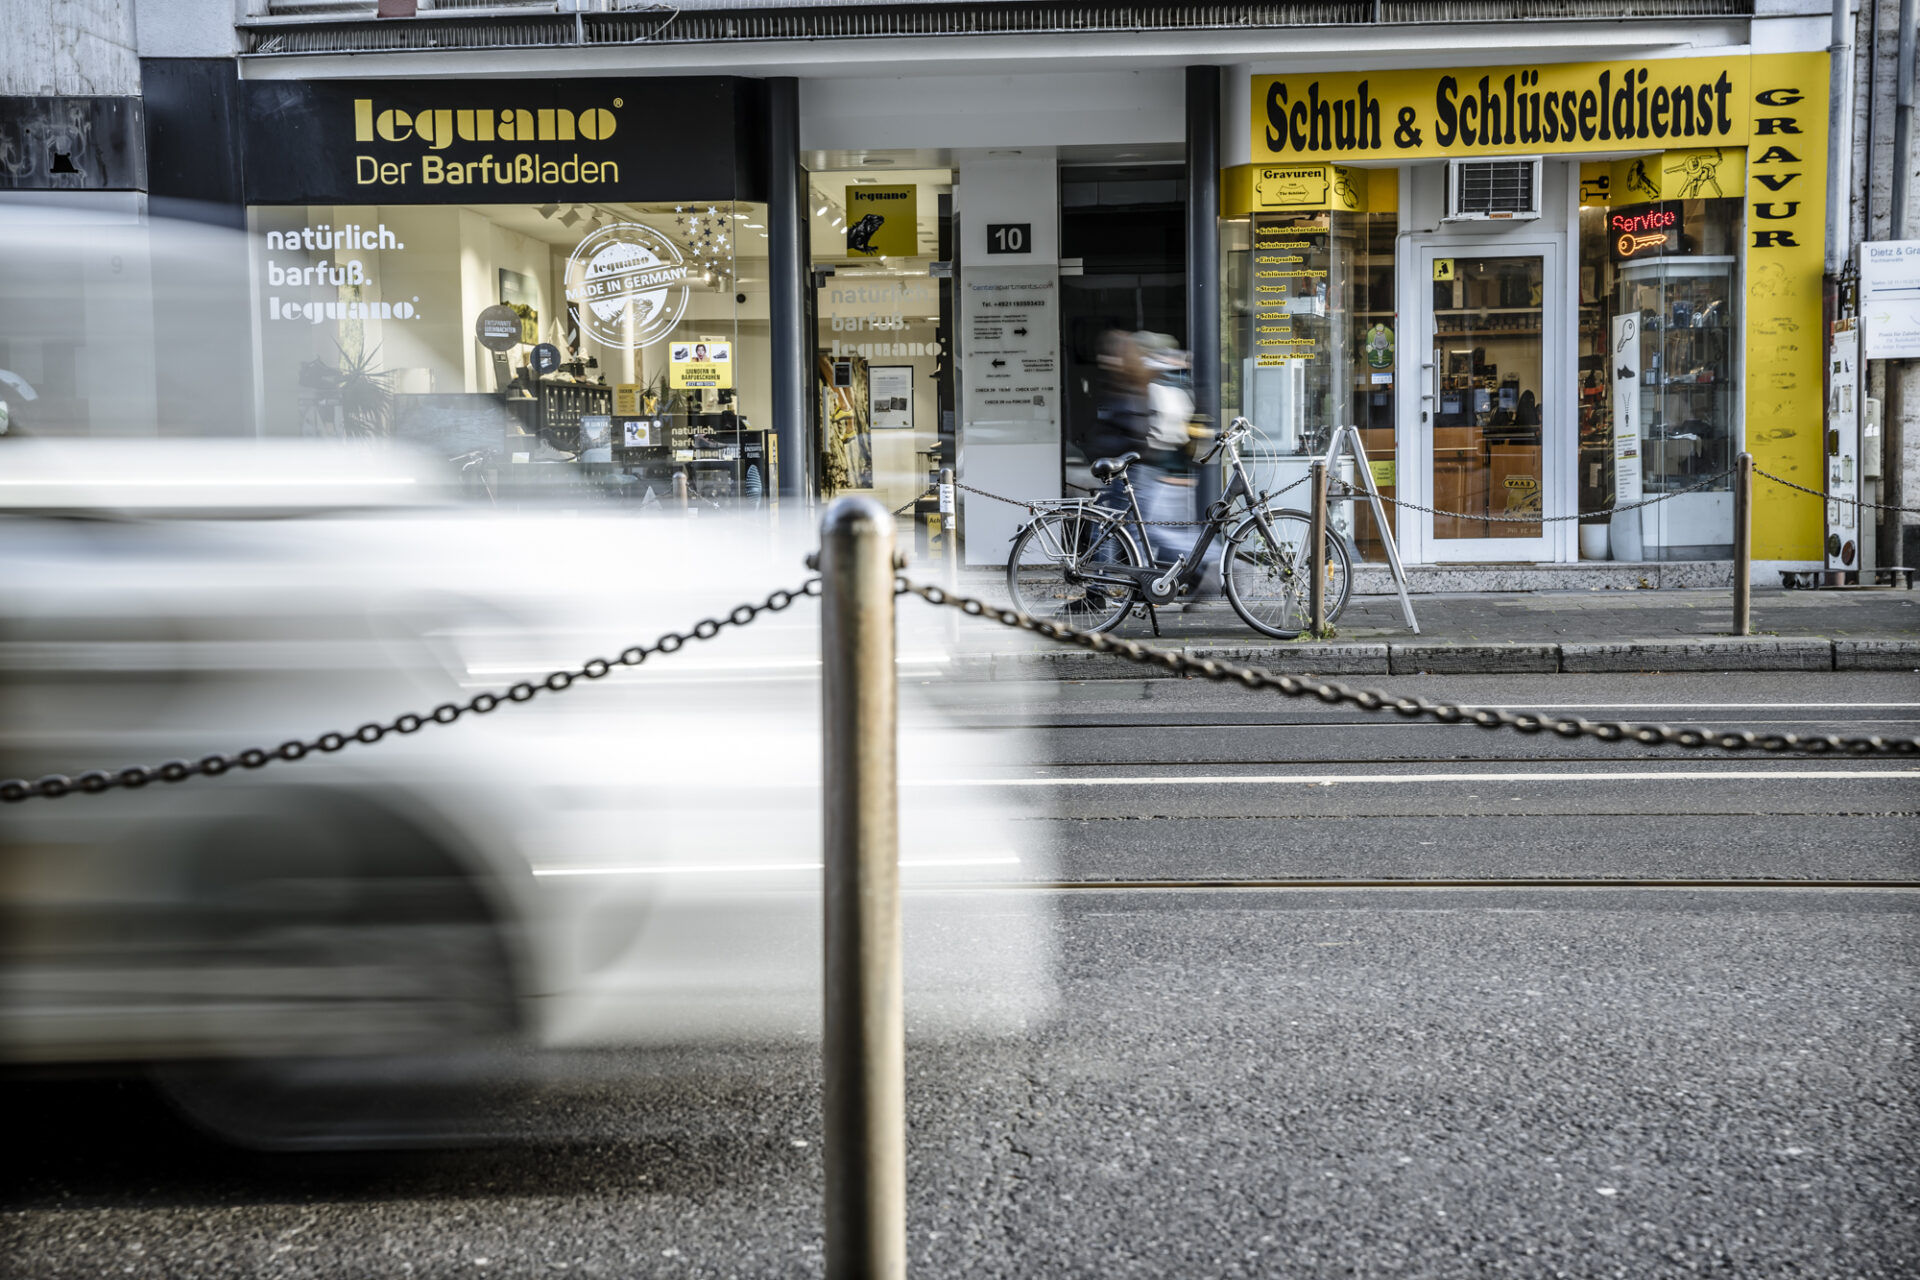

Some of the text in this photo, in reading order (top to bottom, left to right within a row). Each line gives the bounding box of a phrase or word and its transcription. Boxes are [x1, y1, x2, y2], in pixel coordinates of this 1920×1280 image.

[1265, 67, 1733, 153] Schuh & Schlüsseldienst
[356, 153, 620, 185] Der Barfußladen
[1263, 168, 1322, 180] Gravuren
[1751, 88, 1806, 249] GRAVUR
[1612, 210, 1676, 233] Service
[266, 223, 405, 251] natürlich.
[994, 227, 1023, 251] 10
[1870, 247, 1894, 257] Dietz
[1895, 247, 1903, 256] &
[267, 259, 373, 287] barfuß.
[592, 255, 651, 274] leguano
[565, 266, 689, 301] MADE IN GERMANY
[831, 284, 935, 305] natürlich.
[1260, 284, 1287, 293] Stempel
[831, 311, 911, 332] barfuß.
[1260, 325, 1291, 333] Gravuren
[671, 425, 717, 436] natürlich.
